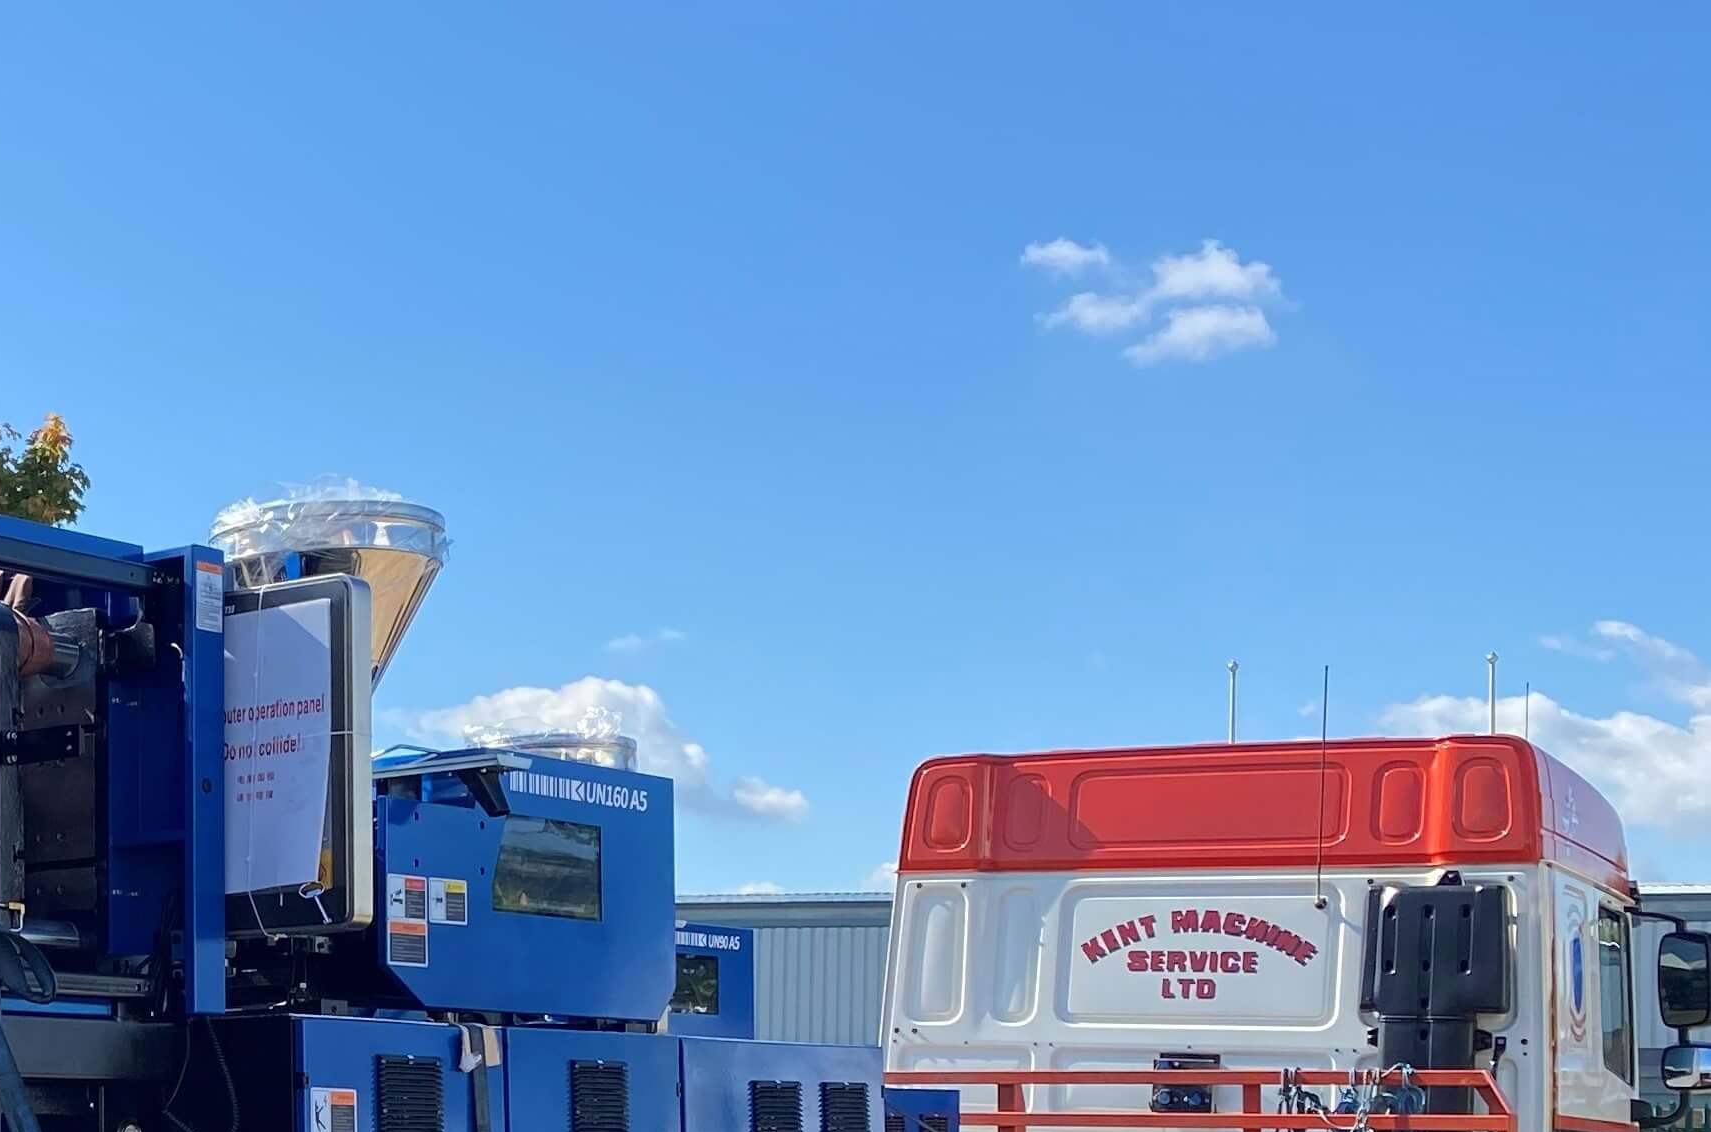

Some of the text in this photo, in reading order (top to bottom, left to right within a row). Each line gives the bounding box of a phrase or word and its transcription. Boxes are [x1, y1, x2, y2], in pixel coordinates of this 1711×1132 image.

[297, 692, 325, 719] panel
[586, 781, 648, 811] UN160 A5
[708, 933, 728, 949] UN90
[1171, 910, 1319, 967] MACHINE
[1127, 951, 1259, 973] SERVICE
[1161, 978, 1216, 999] LTD
